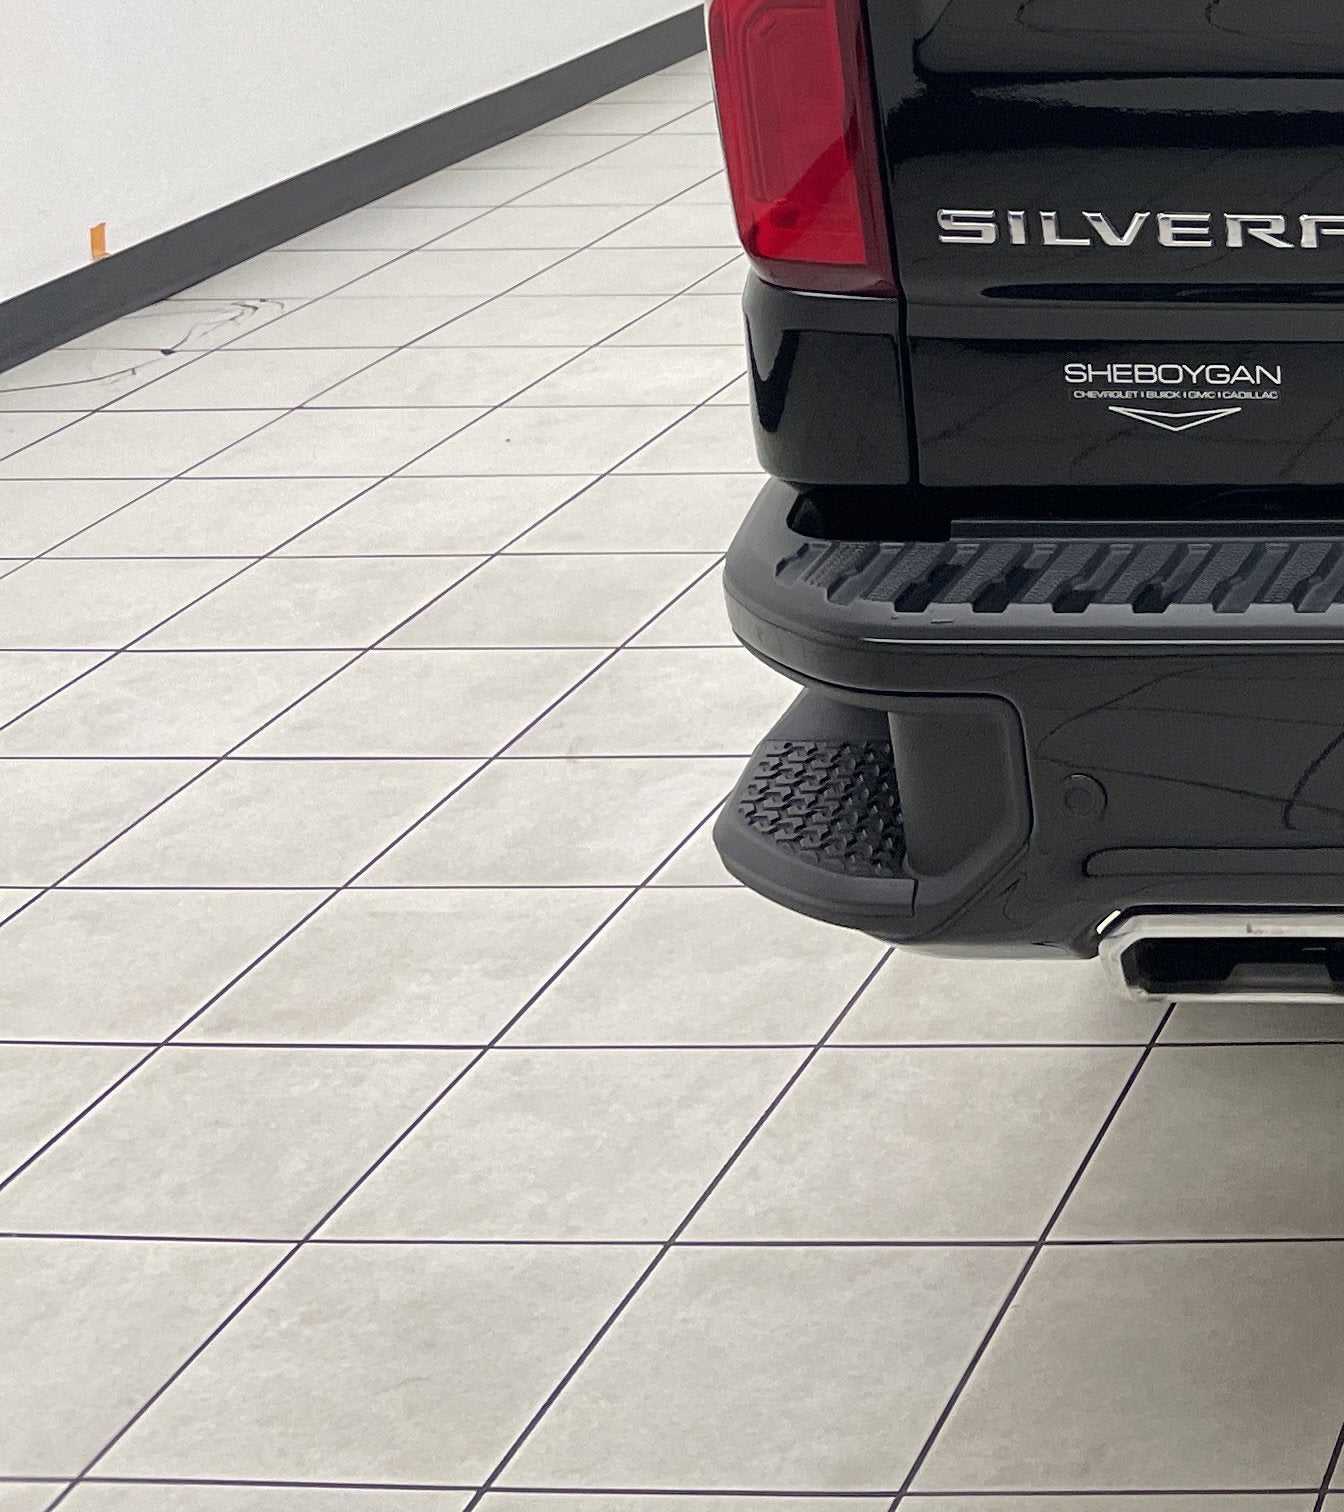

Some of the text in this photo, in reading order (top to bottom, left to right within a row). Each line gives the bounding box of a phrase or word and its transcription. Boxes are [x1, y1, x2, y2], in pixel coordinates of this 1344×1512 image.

[1064, 363, 1282, 385] SHEBOYGAN
[1073, 390, 1279, 400] CHEVROLET BUICK GMC CADILLAC
